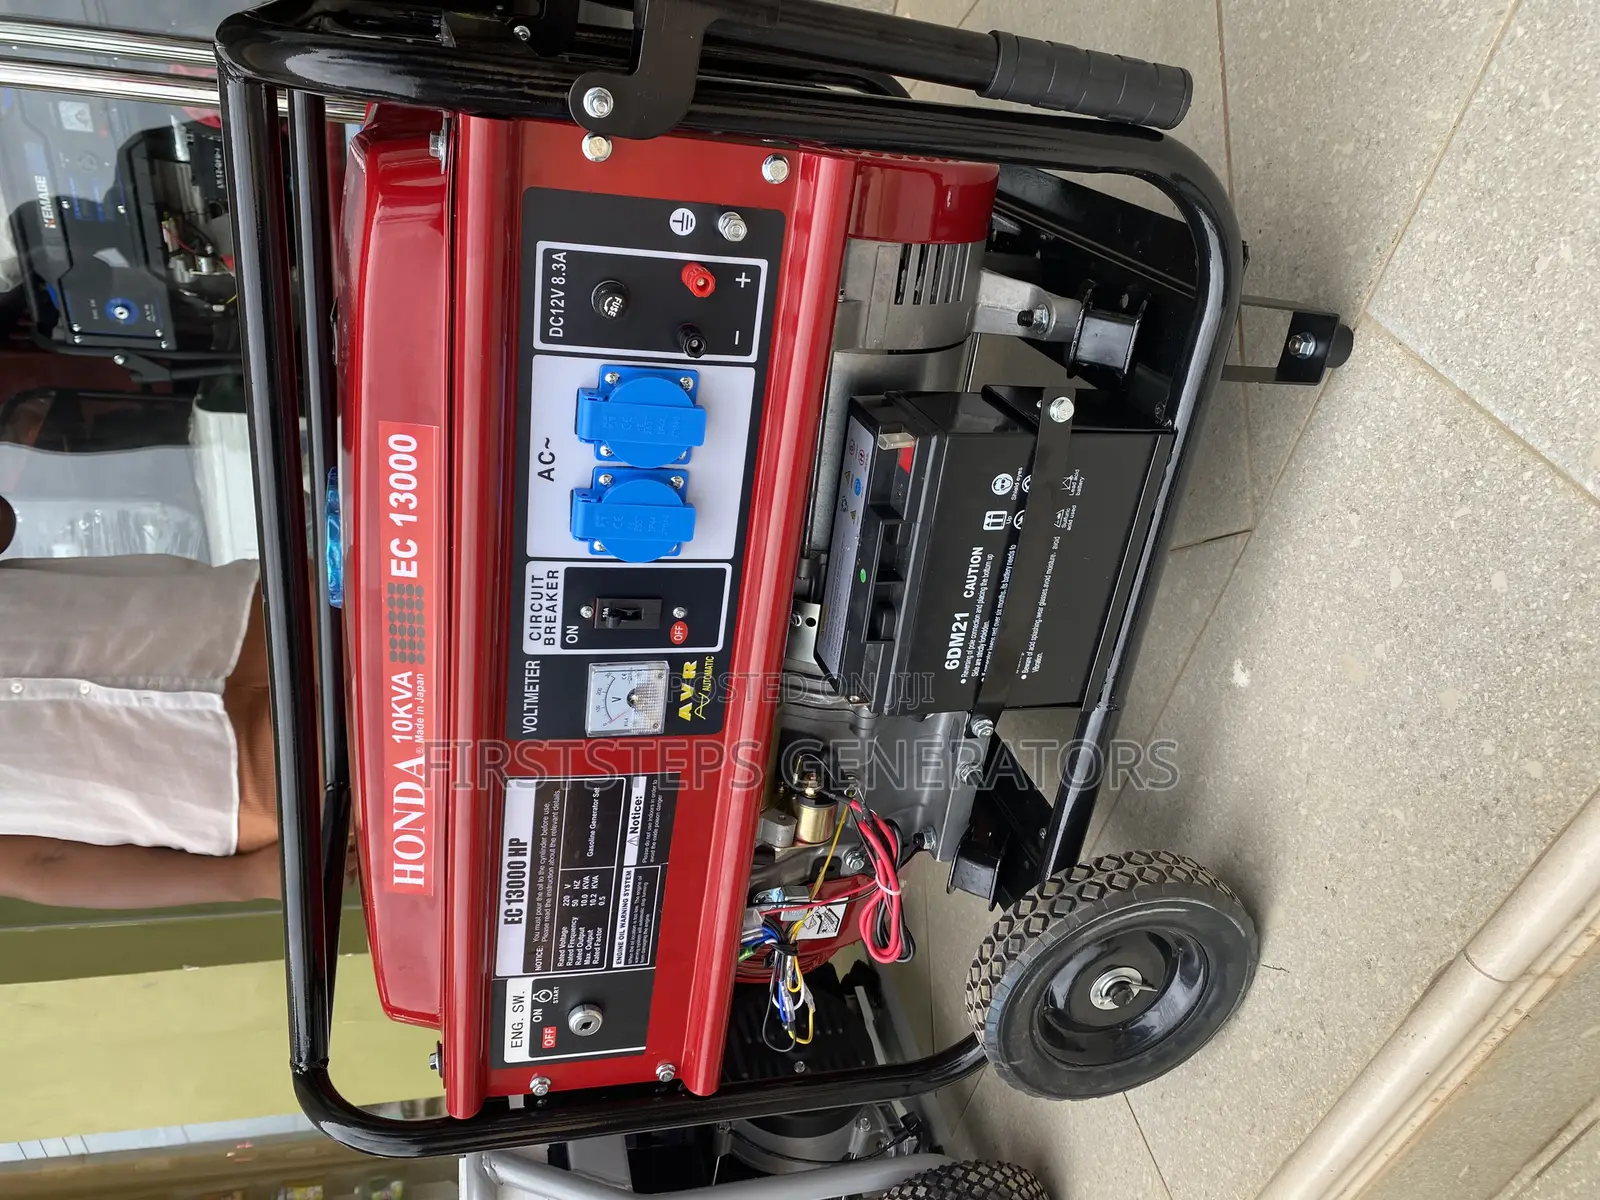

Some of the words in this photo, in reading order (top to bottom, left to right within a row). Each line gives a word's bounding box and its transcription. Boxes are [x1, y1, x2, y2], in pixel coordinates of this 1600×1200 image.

[34, 176, 56, 228] KEMAGE
[550, 251, 567, 284] 8.3A
[548, 288, 565, 336] DC12V
[608, 296, 622, 318] FUSE
[388, 434, 418, 527] 13000
[1010, 482, 1020, 500] Shield
[1016, 466, 1024, 481] eyes
[1072, 468, 1080, 480] acid
[1068, 482, 1078, 496] Lead
[1074, 476, 1085, 496] battery
[1006, 516, 1013, 524] Up
[1060, 508, 1070, 528] Sulfuric
[1069, 504, 1078, 518] used
[1066, 520, 1074, 530] acid
[390, 538, 418, 578] EC
[1006, 550, 1016, 565] needs
[963, 546, 984, 598] CAUTION
[982, 560, 992, 578] bottom
[1002, 566, 1012, 582] battery
[980, 578, 988, 586] the
[976, 586, 988, 604] placing
[1022, 656, 1032, 673] Beware
[1028, 642, 1036, 650] acid
[1052, 536, 1061, 550] avoid
[529, 574, 544, 641] CIRCUIT
[544, 570, 558, 646] BREAKER
[974, 604, 983, 613] and
[970, 614, 982, 638] connection
[978, 620, 990, 643] forbidden.
[993, 616, 1001, 627] over
[566, 626, 579, 644] ON
[674, 625, 684, 640] OFF
[944, 612, 970, 670] 6DM21
[968, 639, 976, 649] pole
[976, 644, 986, 658] strictly
[961, 655, 974, 678] Reversing
[971, 666, 980, 676] Side
[974, 658, 982, 666] are
[702, 656, 715, 691] AUTOMATIC
[415, 673, 427, 703] Japan
[522, 660, 540, 733] VOLTMETER
[678, 660, 698, 721] AVR
[392, 671, 413, 743] 10KVA
[414, 706, 425, 714] in
[414, 718, 425, 743] Made
[592, 787, 600, 798] Set
[655, 794, 664, 811] danger
[392, 754, 426, 887] HONDA
[588, 798, 600, 830] Generator
[629, 796, 642, 834] Notice:
[508, 838, 528, 856] HP
[587, 830, 596, 856] Gasoline
[548, 848, 556, 866] about
[642, 847, 650, 863] Please
[505, 861, 527, 905] 13000
[534, 916, 542, 930] must
[540, 816, 548, 835] before
[546, 866, 554, 897] instruction
[582, 876, 590, 889] KVA
[591, 875, 600, 888] KVA
[623, 870, 632, 896] SYSTEM
[573, 880, 581, 889] HZ
[544, 898, 552, 908] the
[562, 895, 570, 906] 220
[580, 894, 588, 906] 10.0
[598, 896, 606, 906] 0.5
[504, 908, 524, 924] EC
[620, 898, 629, 928] WARNING
[542, 922, 550, 942] Please
[559, 926, 568, 948] Voltage
[568, 916, 579, 948] Frequency
[577, 926, 586, 947] Output
[586, 930, 594, 950] Output
[594, 927, 602, 946] Factor
[535, 945, 545, 970] NOTICE:
[558, 950, 566, 966] Rated
[566, 949, 574, 966] Rated
[575, 948, 583, 966] Rated
[584, 951, 592, 964] Max.
[592, 947, 600, 964] Rated
[616, 942, 624, 964] ENGINE
[512, 990, 525, 1012] SW.
[532, 1008, 543, 1022] ON
[510, 1018, 524, 1048] ENG.
[545, 1028, 554, 1046] OFF
